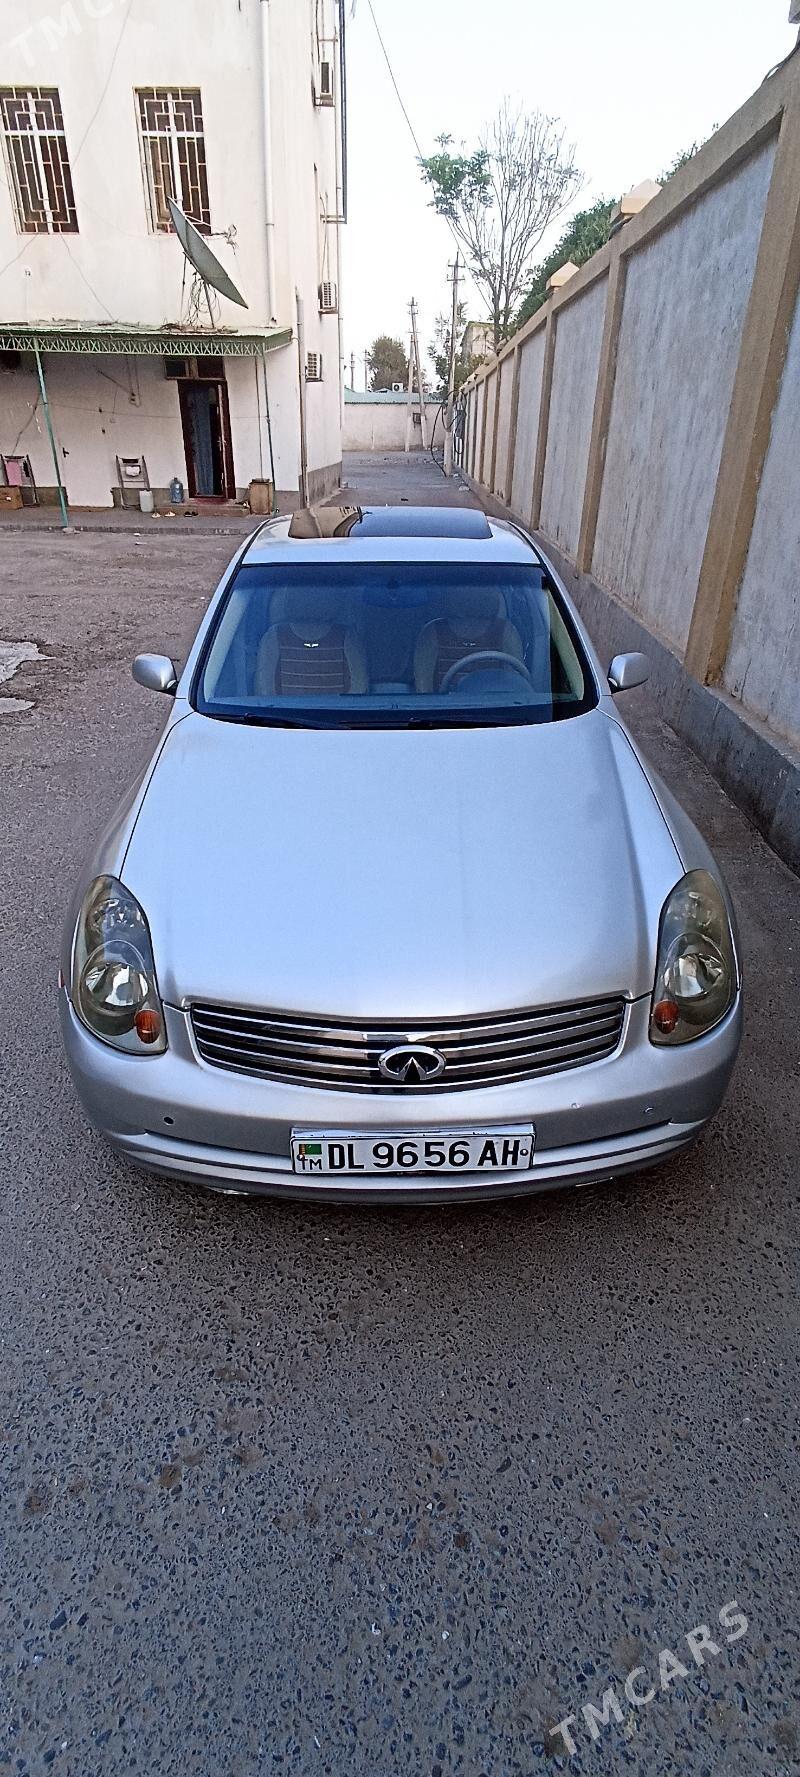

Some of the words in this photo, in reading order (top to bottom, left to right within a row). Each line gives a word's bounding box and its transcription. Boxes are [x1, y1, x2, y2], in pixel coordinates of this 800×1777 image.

[300, 1158, 323, 1171] TM
[328, 1143, 365, 1170] DL
[372, 1141, 471, 1168] 9656
[477, 1139, 521, 1167] AH
